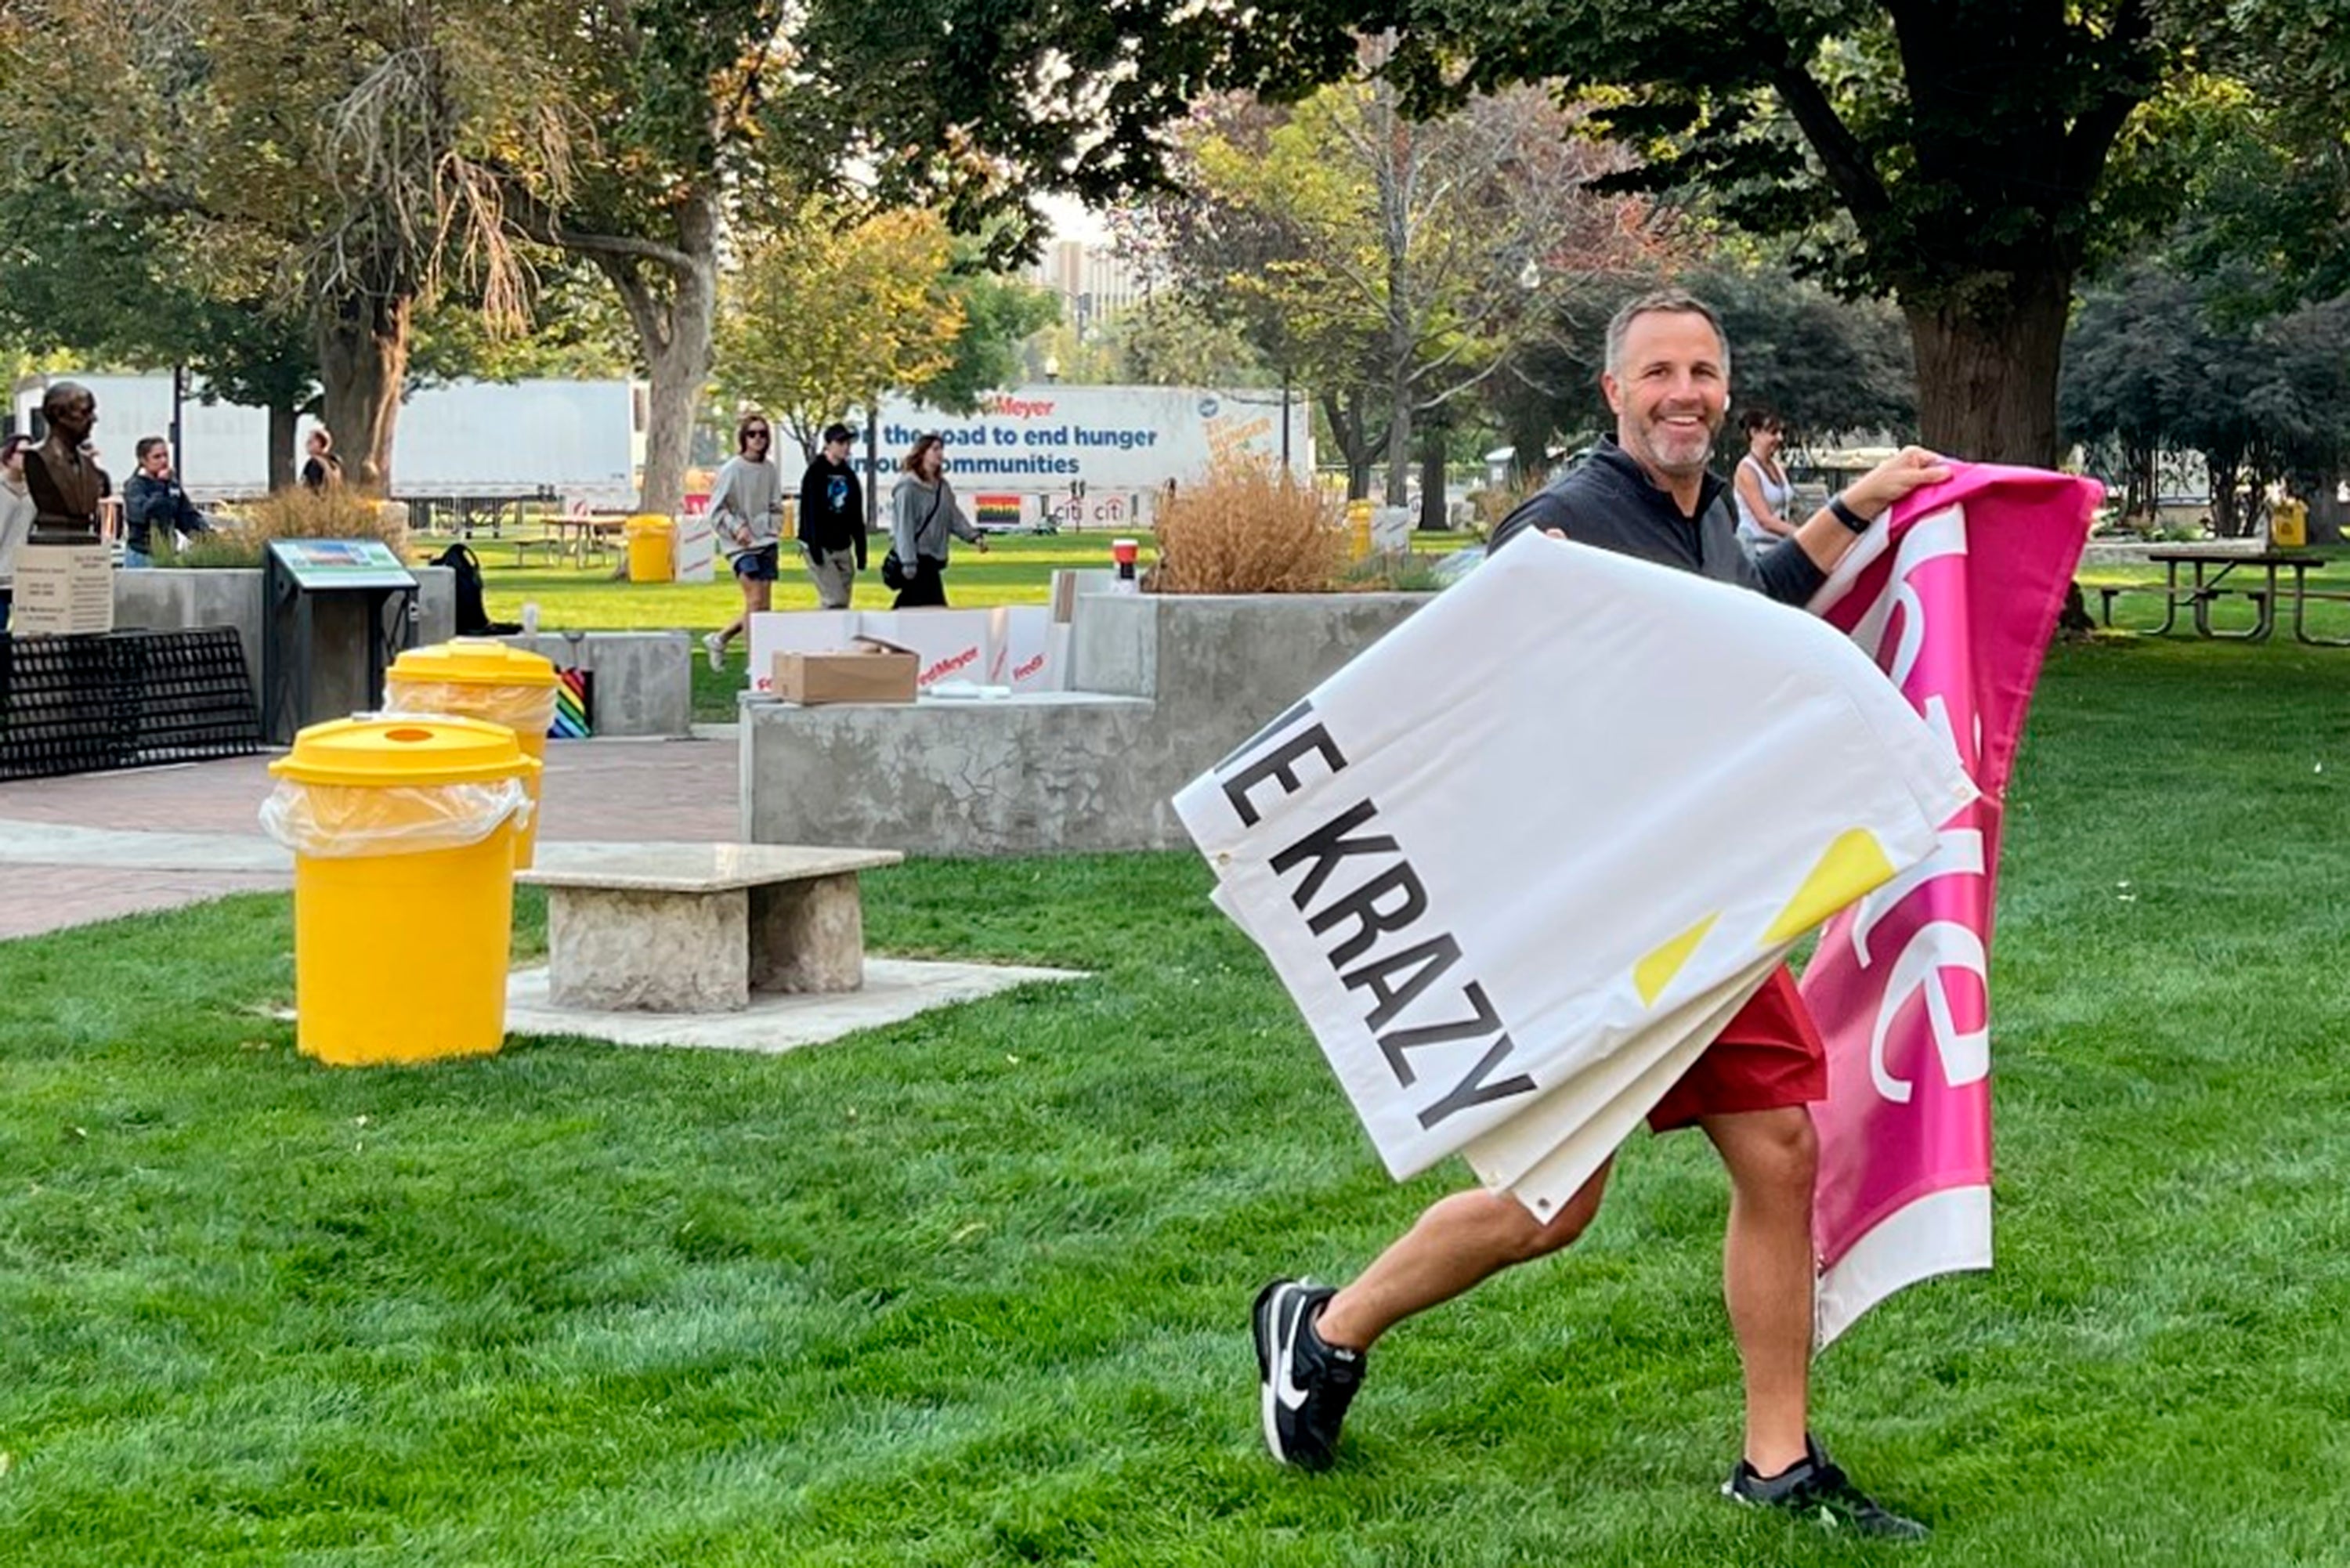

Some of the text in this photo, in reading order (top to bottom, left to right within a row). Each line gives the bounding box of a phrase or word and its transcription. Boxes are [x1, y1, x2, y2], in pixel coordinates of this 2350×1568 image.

[932, 425, 986, 446] oad
[993, 427, 1018, 446] to
[1024, 425, 1068, 446] end
[1074, 425, 1159, 450] hunger
[940, 452, 1080, 475] ommunities
[1094, 501, 1123, 521] citi
[1267, 797, 1538, 1131] KRAZY
